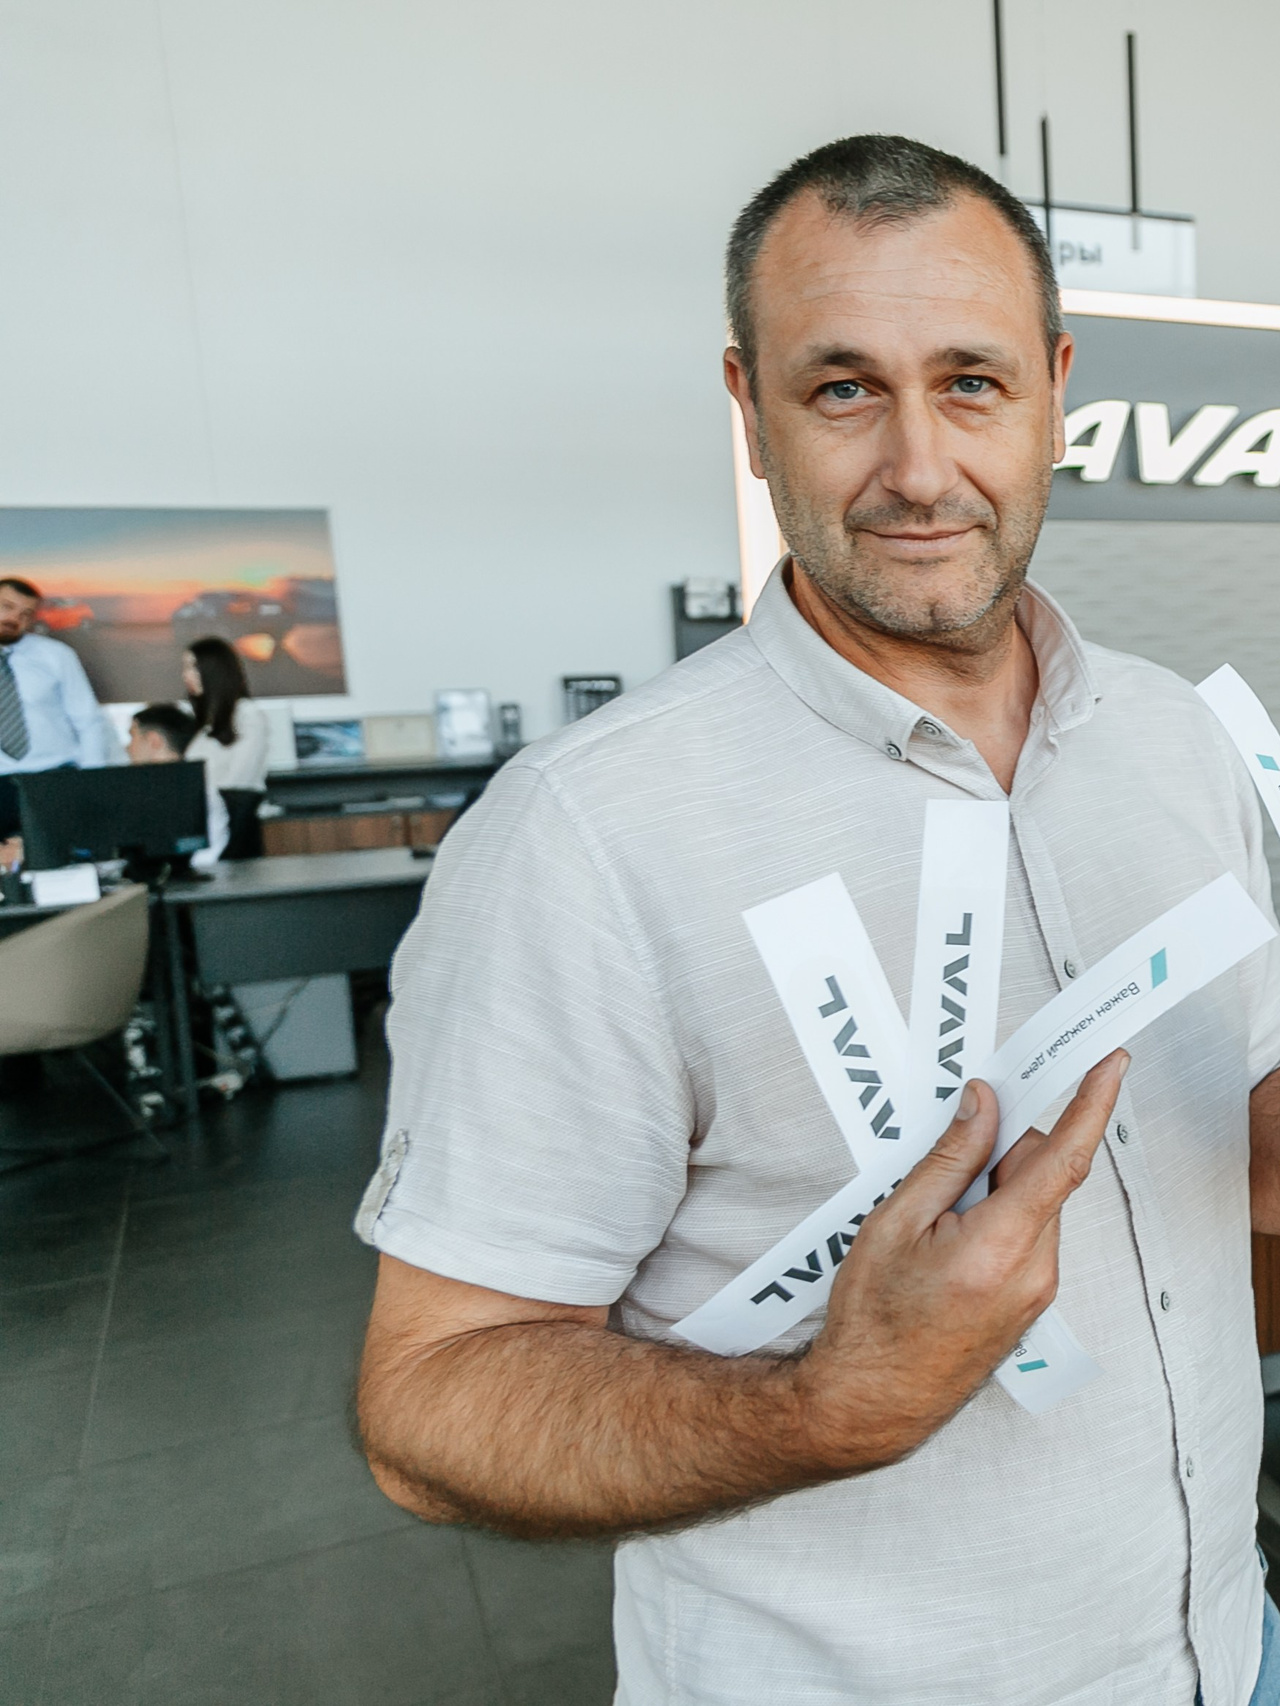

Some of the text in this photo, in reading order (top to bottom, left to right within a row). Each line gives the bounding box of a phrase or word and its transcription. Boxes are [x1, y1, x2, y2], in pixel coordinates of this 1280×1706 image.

[1020, 982, 1141, 1081] Важен каждый день
